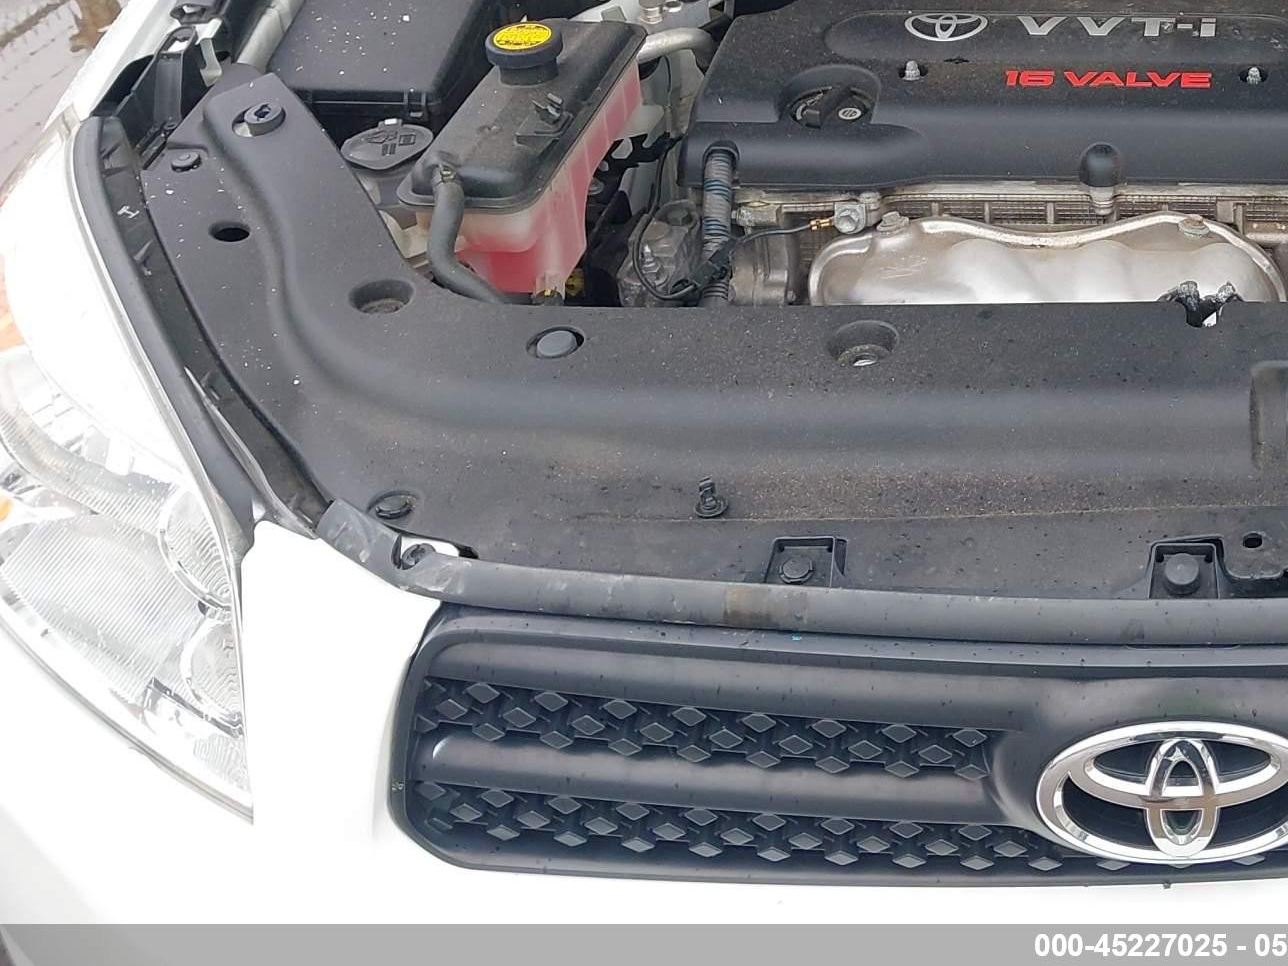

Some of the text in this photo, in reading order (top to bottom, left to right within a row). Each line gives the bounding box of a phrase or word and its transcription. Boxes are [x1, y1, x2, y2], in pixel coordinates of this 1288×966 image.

[1016, 15, 1217, 38] VVT-i
[1004, 69, 1213, 89] 16 VALVE
